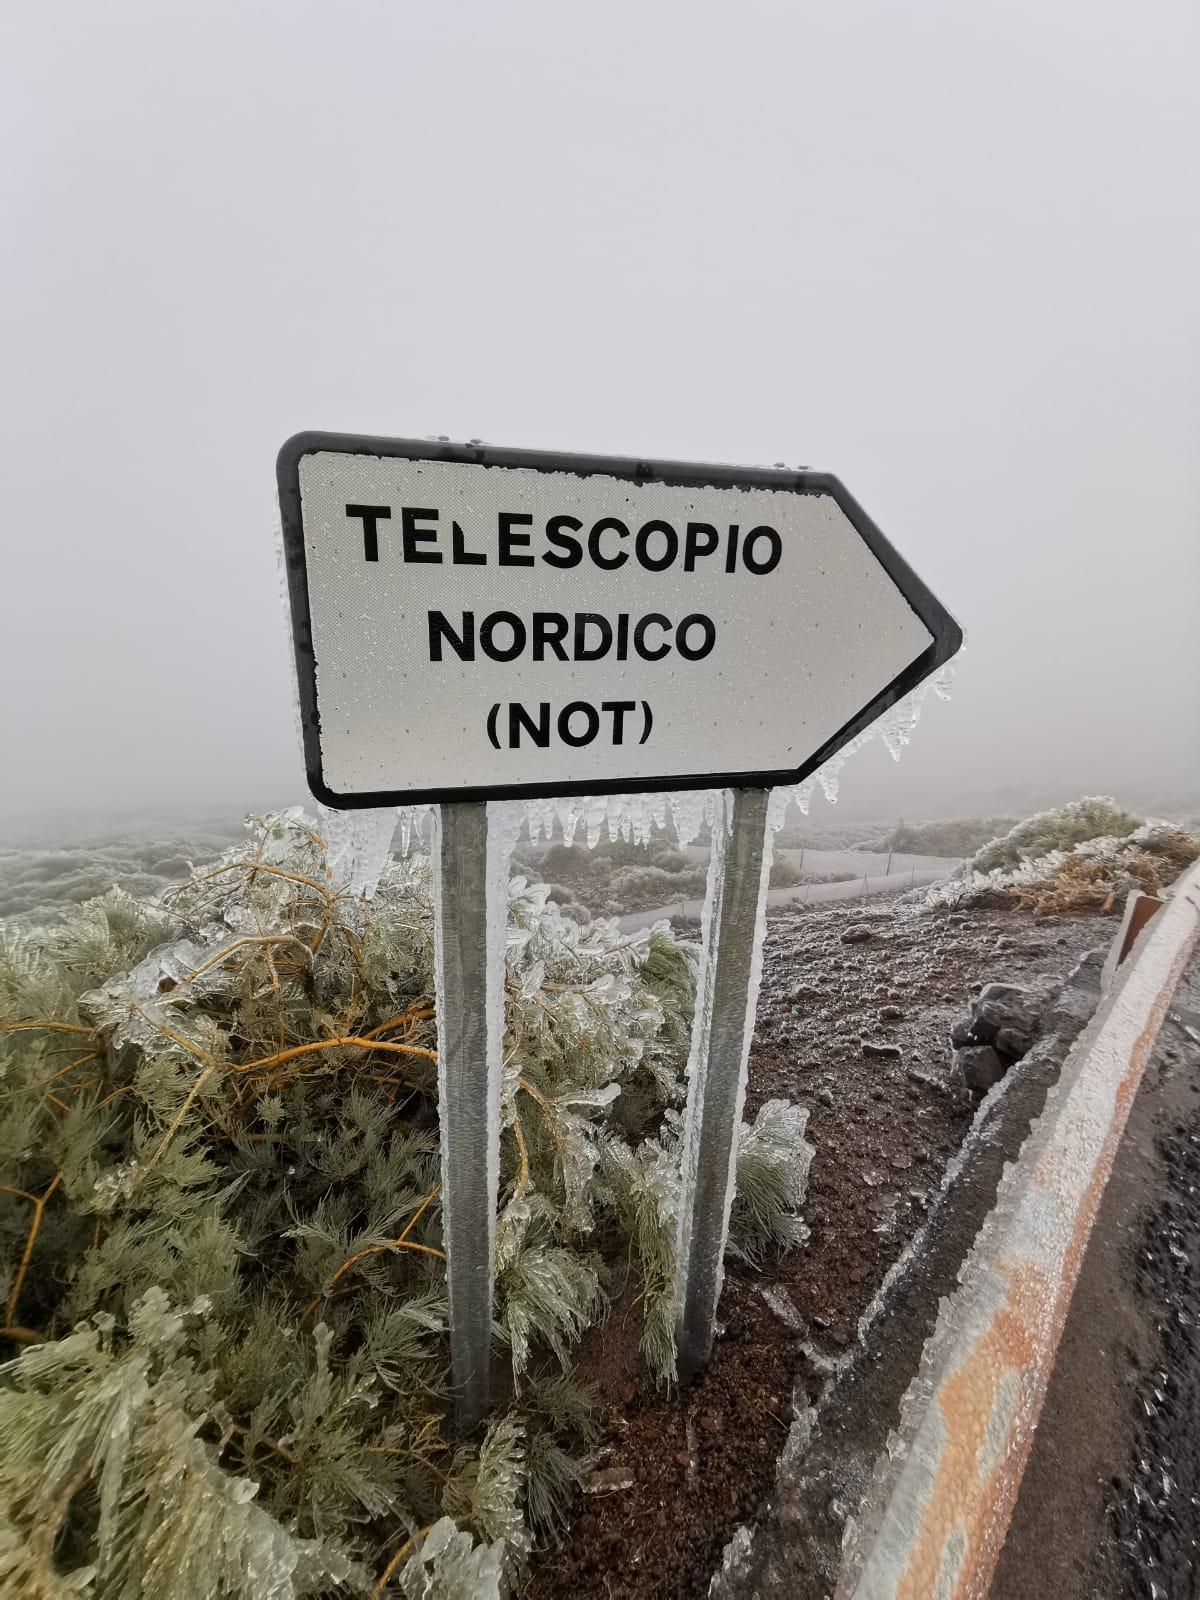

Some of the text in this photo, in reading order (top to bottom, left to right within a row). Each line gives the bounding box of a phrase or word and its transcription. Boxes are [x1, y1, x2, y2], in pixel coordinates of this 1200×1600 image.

[345, 503, 783, 576] TELESCOPIO
[427, 610, 716, 662] NORDICO
[486, 700, 653, 749] (NOT)
